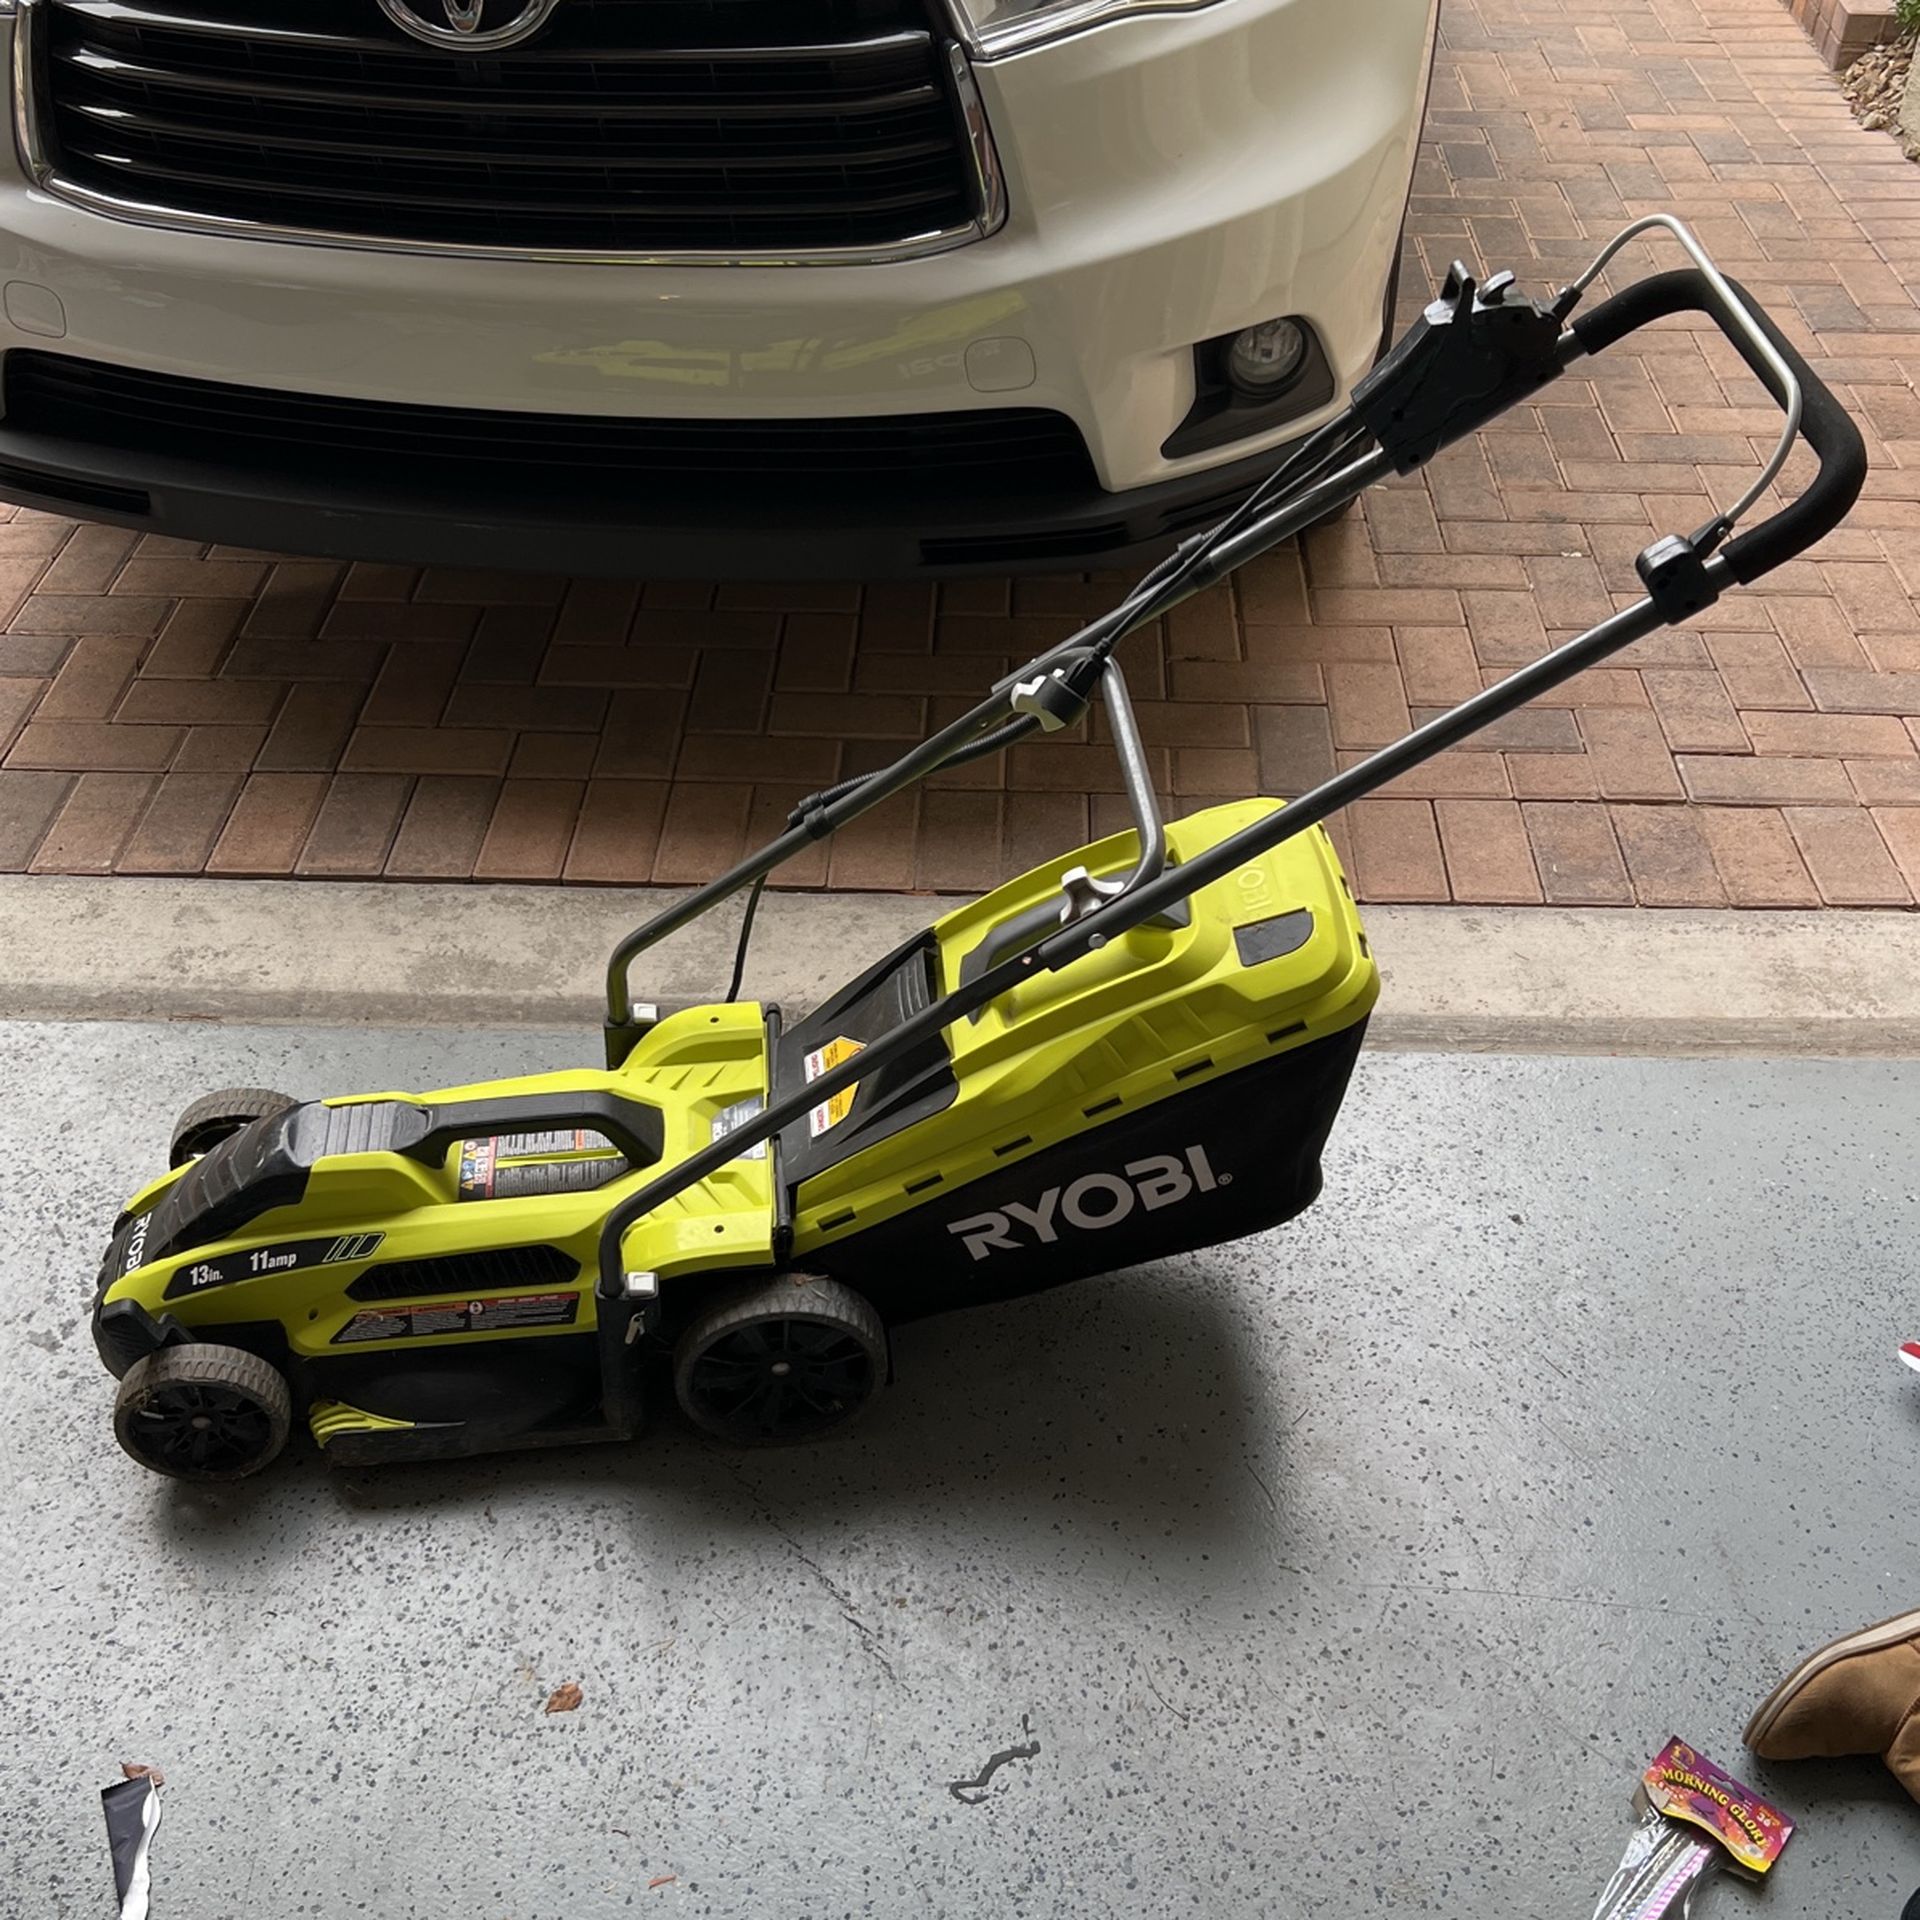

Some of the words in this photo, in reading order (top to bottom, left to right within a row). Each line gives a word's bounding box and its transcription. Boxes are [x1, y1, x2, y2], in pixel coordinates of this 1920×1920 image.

[946, 1144, 1218, 1261] RYOBI
[190, 1265, 223, 1286] 13in.
[250, 1251, 297, 1272] 11amp
[1661, 1767, 1730, 1807] MORNING
[1728, 1803, 1770, 1850] GLORY
